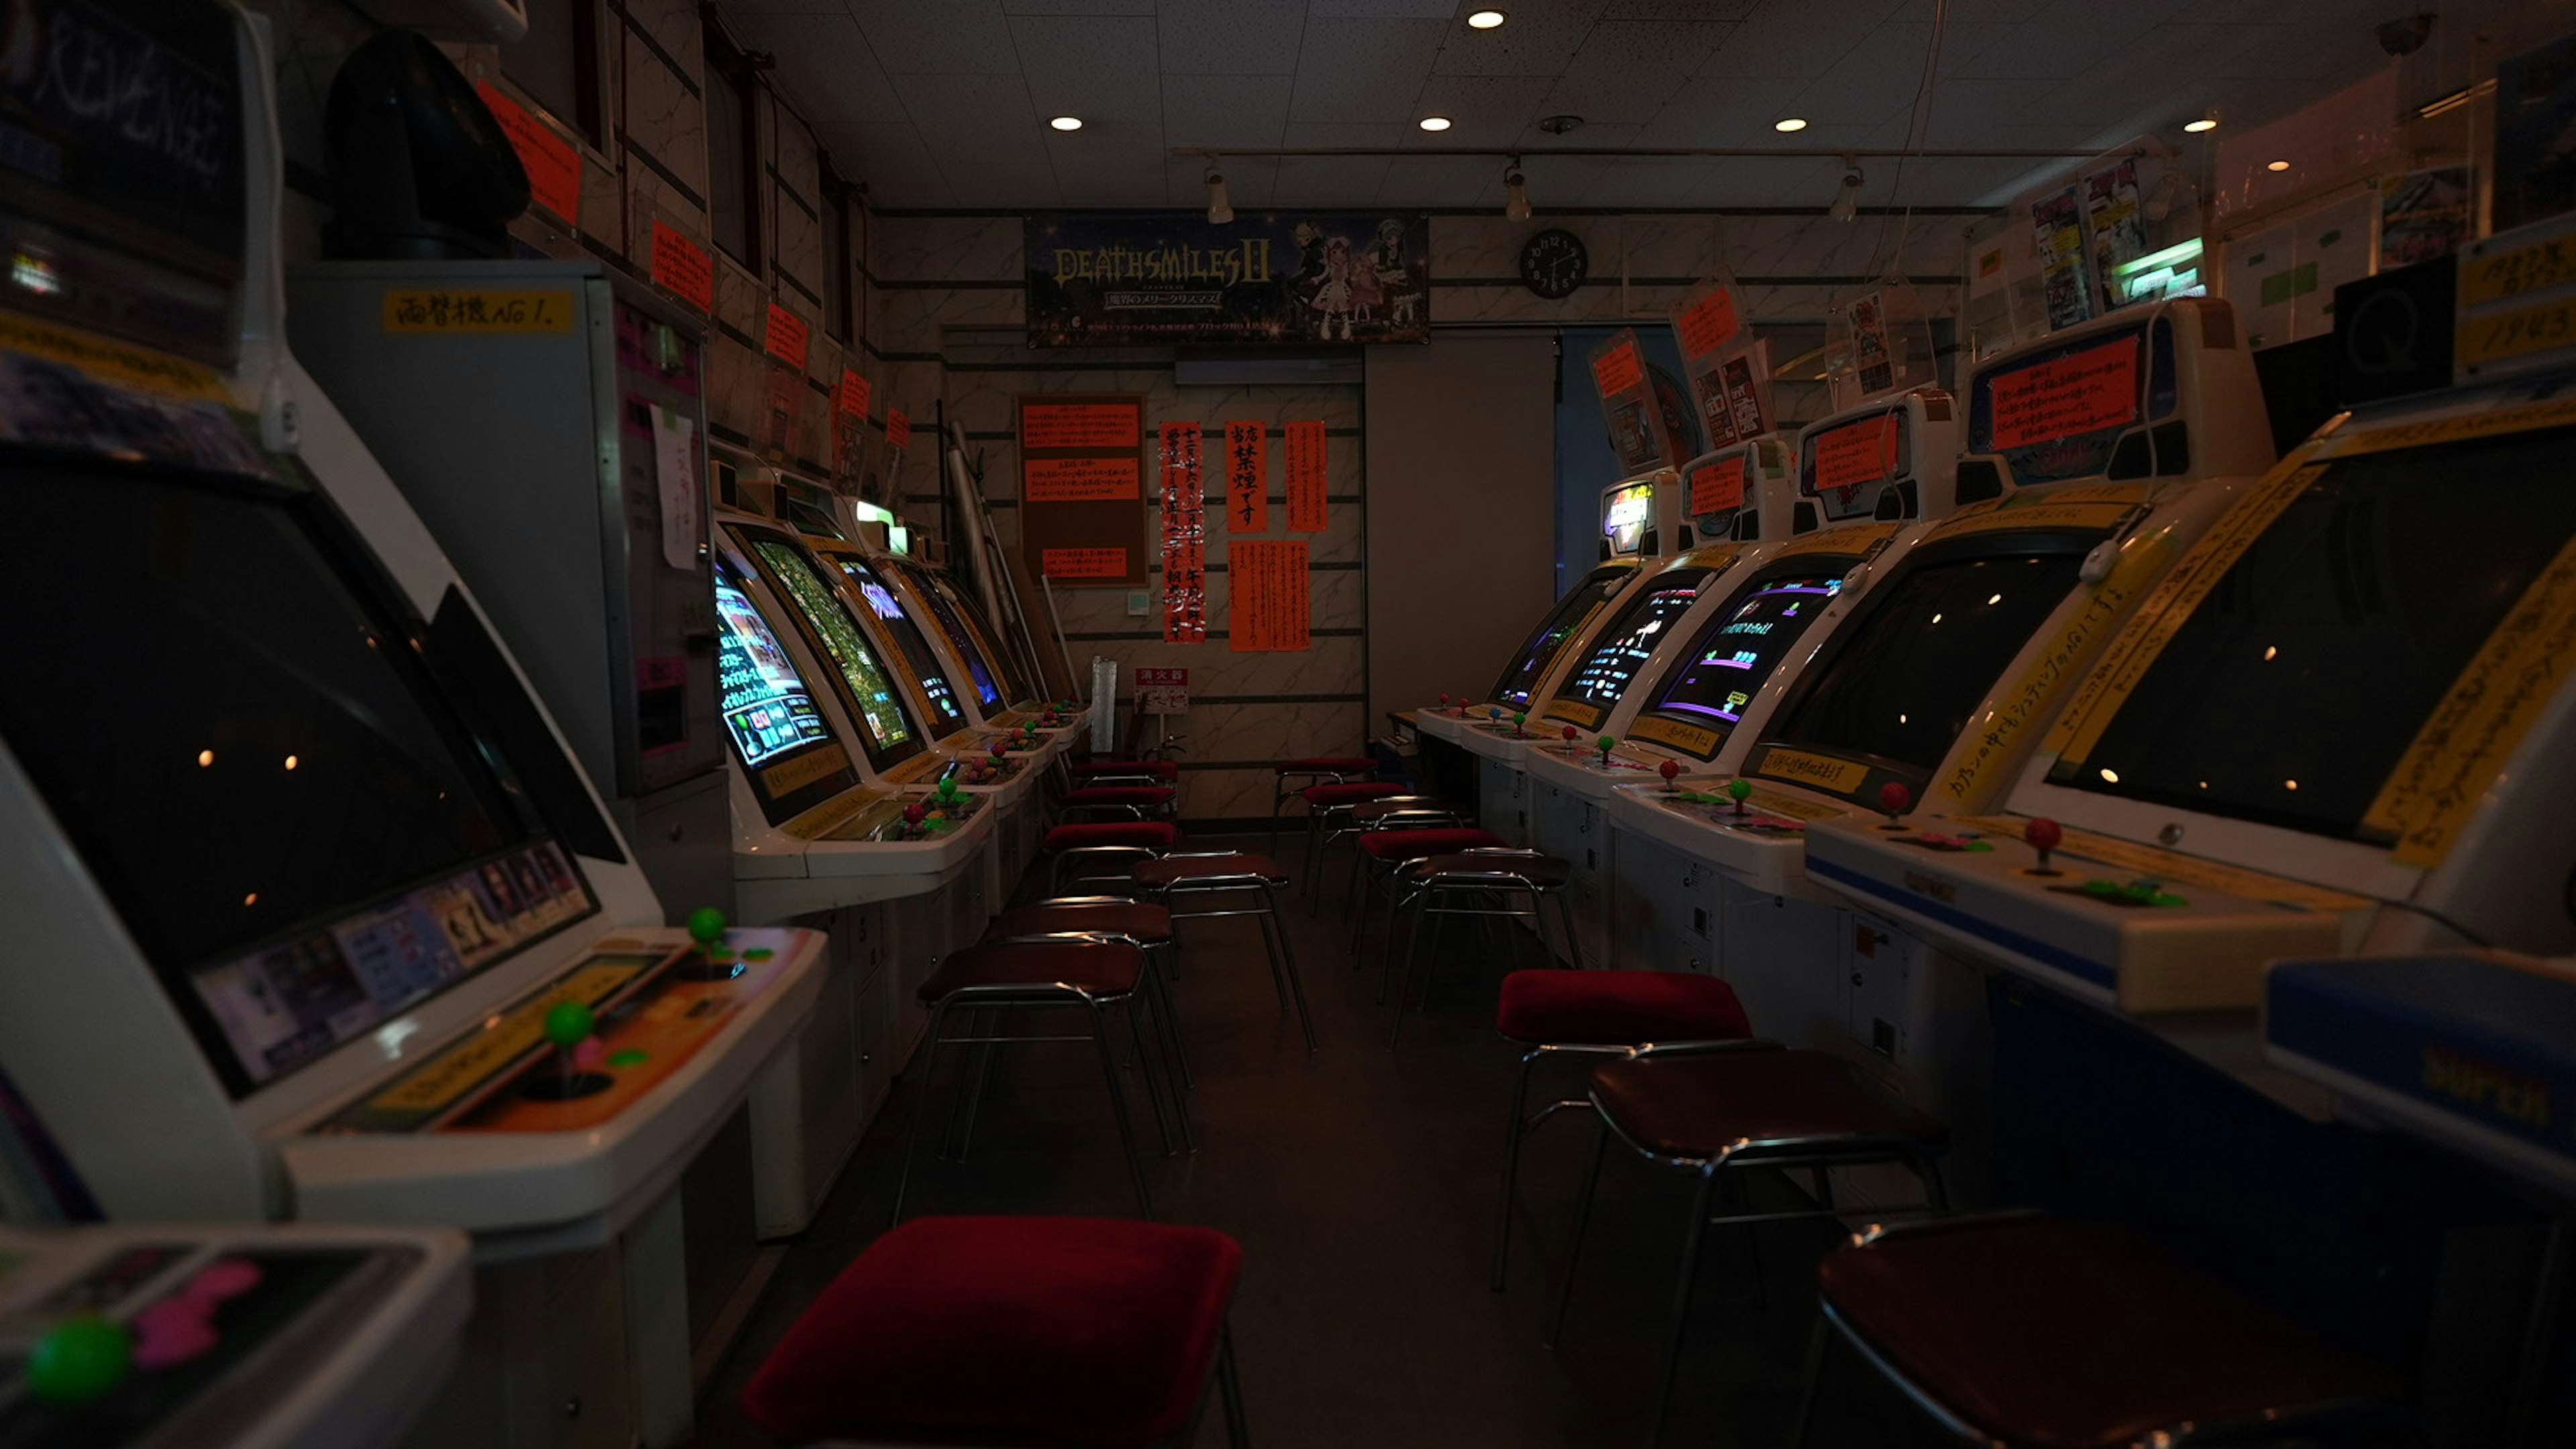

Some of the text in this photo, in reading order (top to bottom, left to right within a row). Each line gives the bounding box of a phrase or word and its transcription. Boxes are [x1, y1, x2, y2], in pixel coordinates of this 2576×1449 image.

[1541, 240, 1548, 248] 11
[1550, 237, 1559, 246] 12
[1563, 239, 1568, 248] 1
[1532, 248, 1541, 257] 10
[1570, 248, 1578, 257] 2
[1052, 244, 1242, 290] DEATHSMILES
[1528, 259, 1535, 268] 9
[1574, 259, 1580, 268] 3
[1534, 270, 1540, 280] 8
[1570, 271, 1576, 279] 4
[1542, 278, 1548, 288] 7
[1551, 282, 1558, 291] 6
[1562, 279, 1568, 288] 5
[2347, 288, 2420, 374] Q
[2482, 308, 2569, 352] 1943
[1232, 445, 1258, 527] 禁煙です
